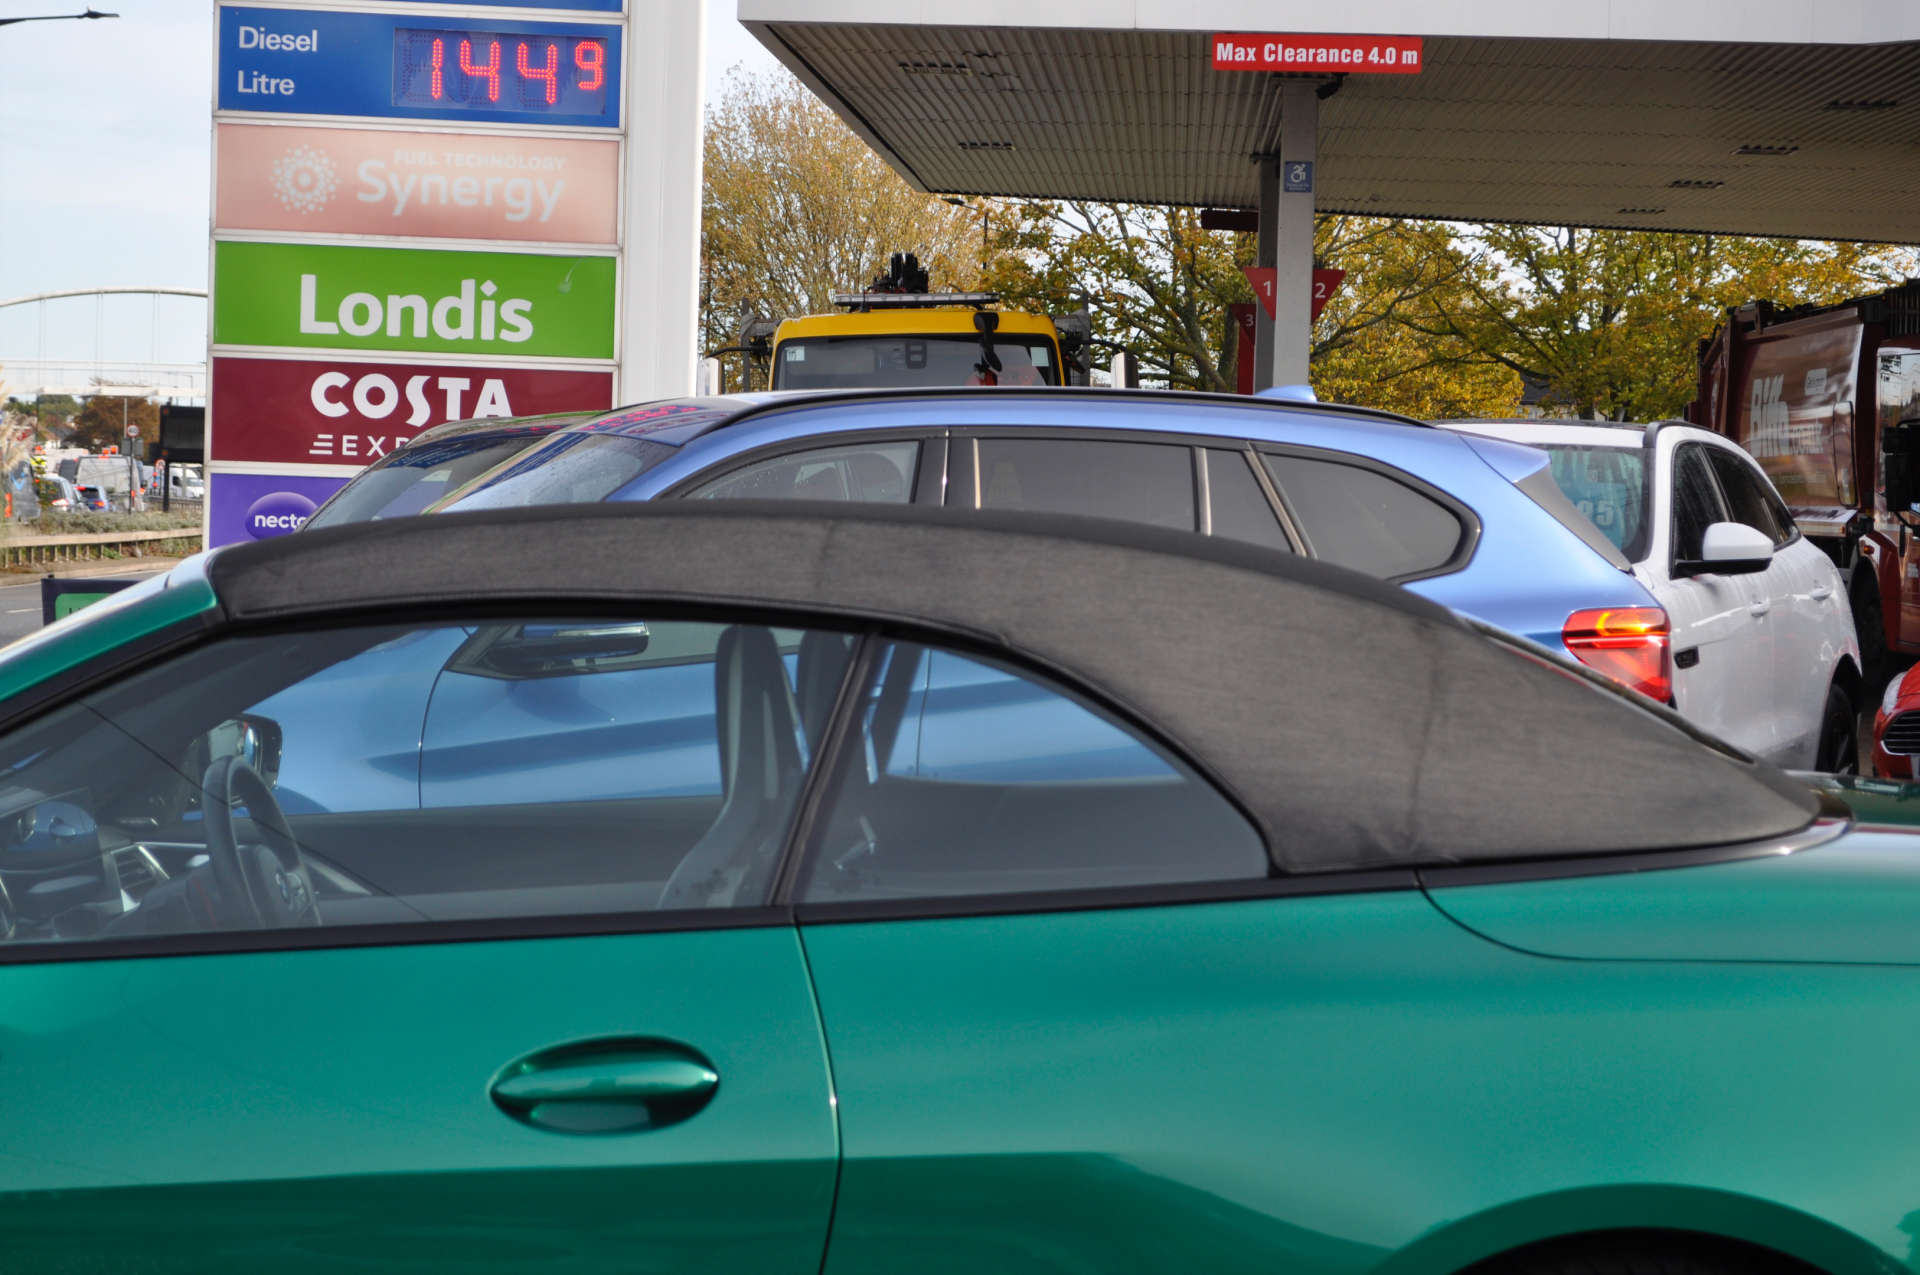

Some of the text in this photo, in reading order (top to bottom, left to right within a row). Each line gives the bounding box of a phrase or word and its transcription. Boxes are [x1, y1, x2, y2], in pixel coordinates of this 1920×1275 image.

[239, 26, 318, 52] Diesel
[1216, 43, 1417, 64] Max Clearance 4.0 m
[238, 70, 295, 95] Litre
[394, 150, 567, 170] FUEL TECHNOLOGY
[357, 160, 566, 222] Synergy
[1263, 281, 1272, 296] 1
[1314, 283, 1326, 298] 2
[300, 274, 534, 342] Londis
[1244, 314, 1254, 327] 3
[310, 371, 513, 427] COSTA
